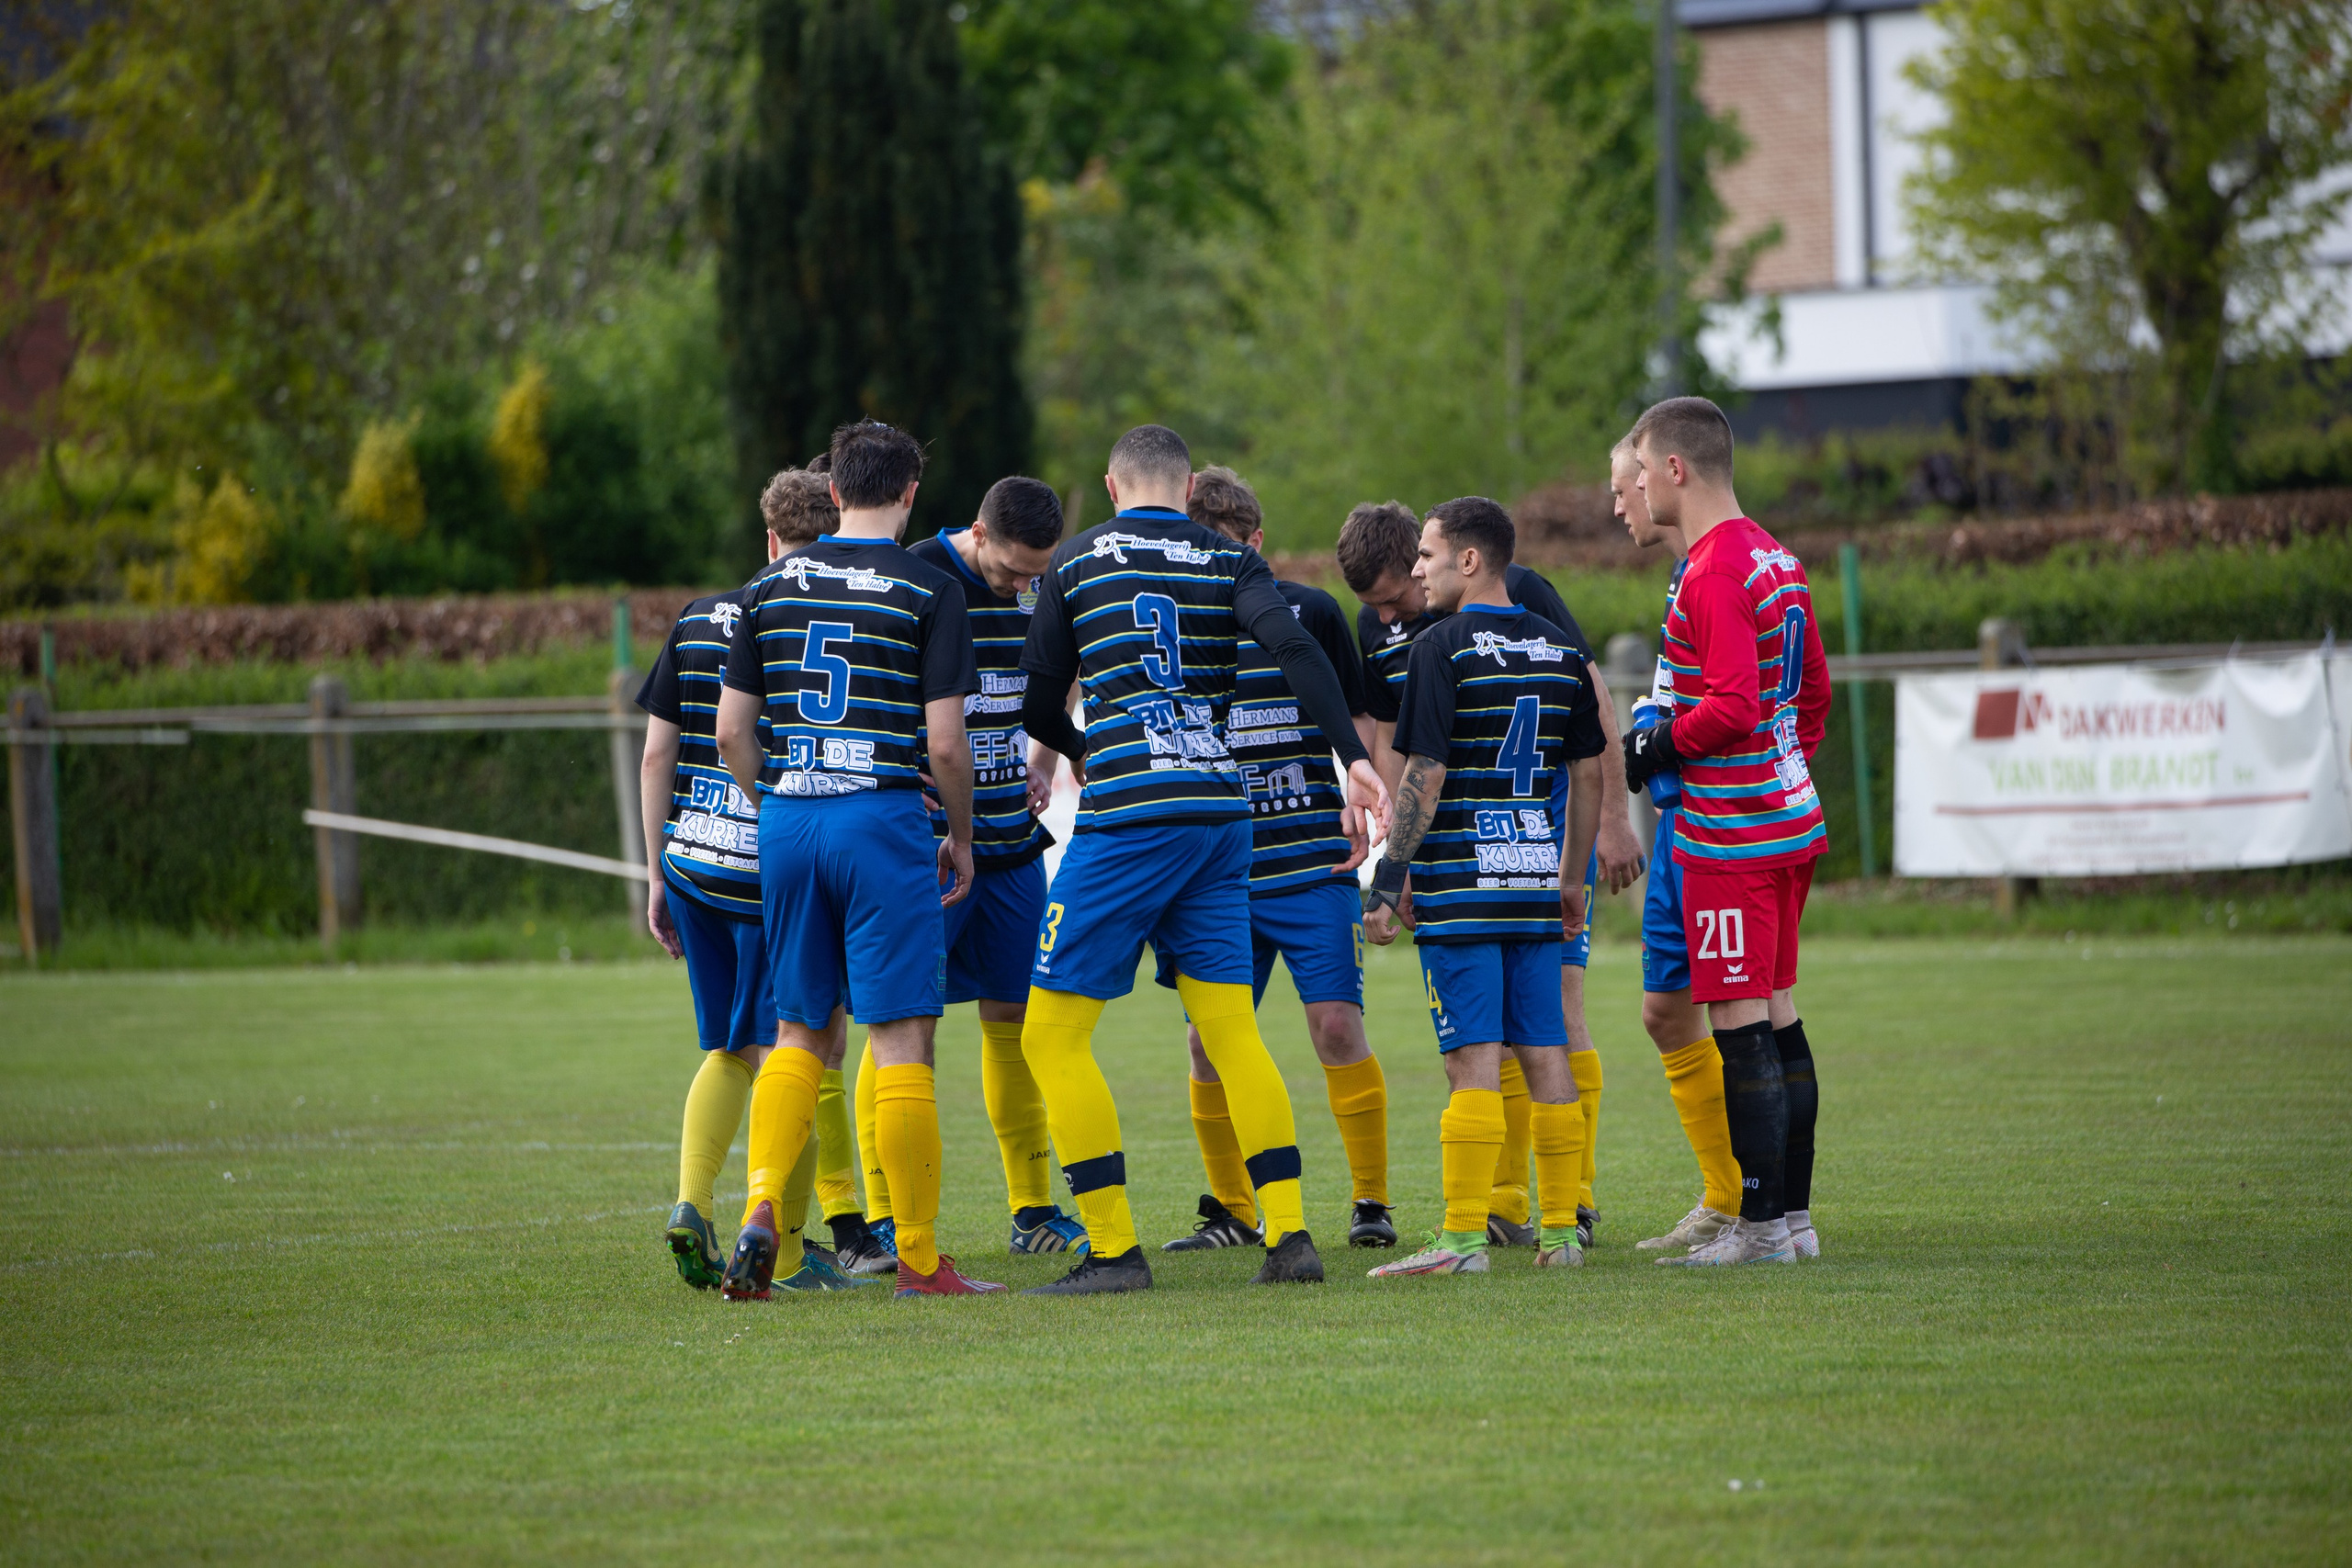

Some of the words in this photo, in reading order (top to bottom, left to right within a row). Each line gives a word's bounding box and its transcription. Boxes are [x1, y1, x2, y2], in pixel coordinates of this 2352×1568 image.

[1131, 538, 1191, 551] Hoeveslagerij
[818, 567, 874, 579] Hoeveslagerij
[1133, 592, 1186, 691] 3
[1386, 633, 1408, 645] erima
[797, 620, 854, 724] 5
[1229, 707, 1298, 728] HERMANS
[1231, 731, 1277, 748] SERVICE
[1279, 731, 1302, 742] BVBA
[1496, 695, 1544, 796] 4
[788, 736, 816, 772] BIJ
[823, 739, 875, 772] DE
[1151, 760, 1174, 769] BIER
[1239, 763, 1306, 801] FM
[691, 776, 727, 817] BIJ
[674, 810, 759, 855] KURRE
[1475, 810, 1519, 843] BIJ
[690, 847, 718, 863] VOETBAL
[1478, 878, 1499, 887] BIER
[1508, 878, 1540, 887] VOETBAL
[1040, 902, 1064, 952] 3
[1696, 908, 1744, 959] 20
[1724, 975, 1749, 983] erima
[1427, 968, 1442, 1016] 4
[1439, 1026, 1455, 1037] erima
[1029, 1149, 1050, 1161] JAK
[1742, 1177, 1759, 1189] AKO
